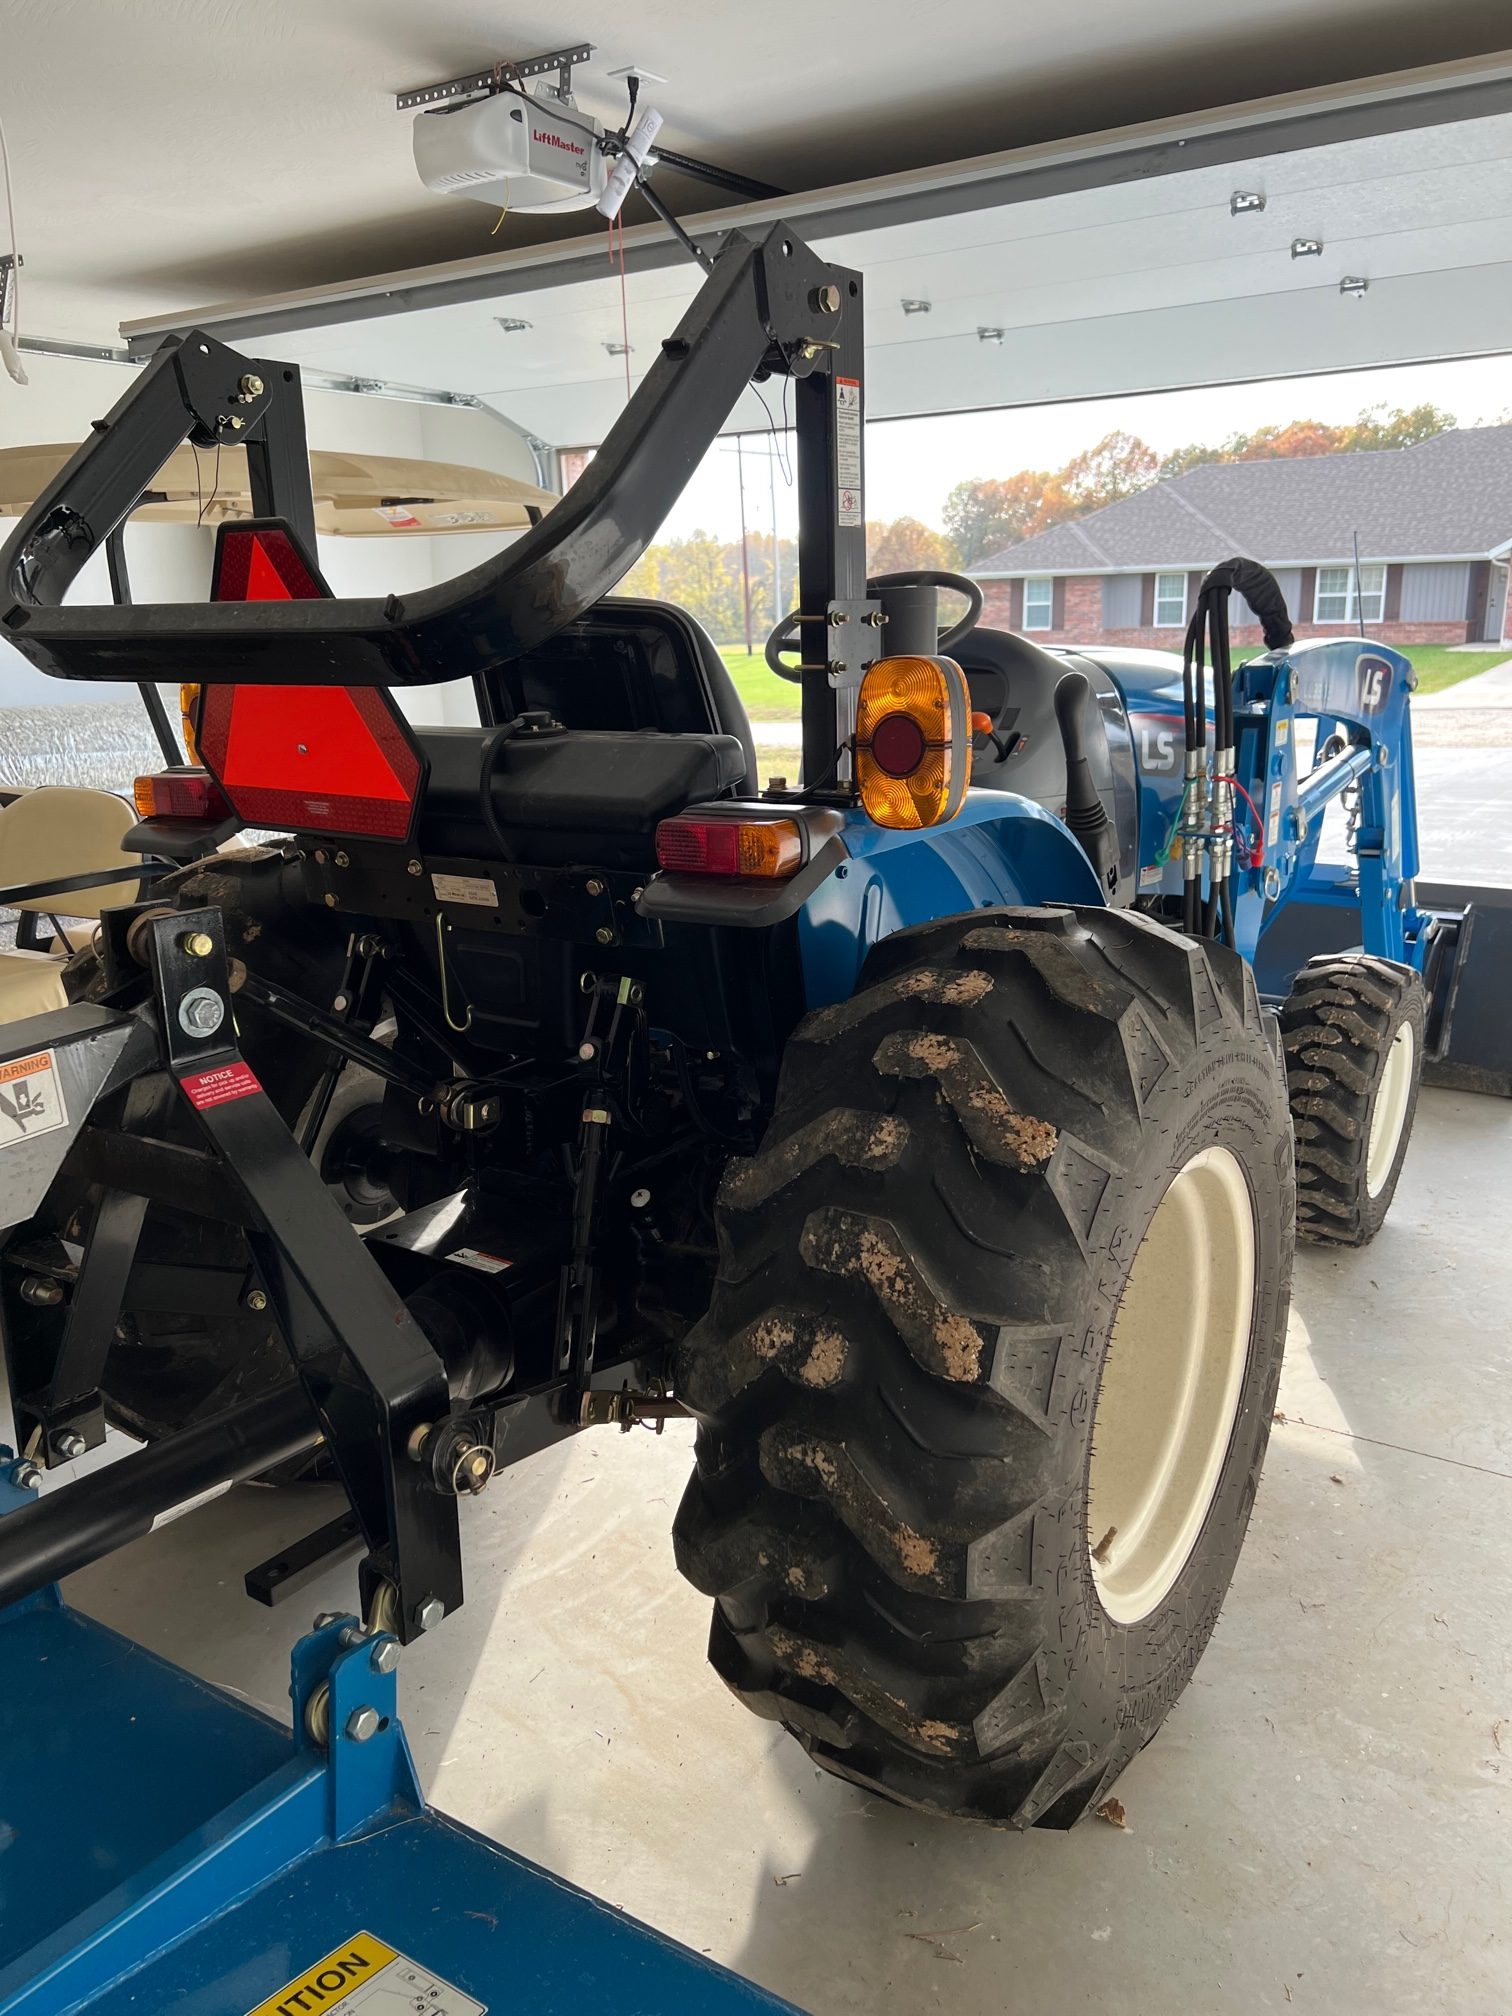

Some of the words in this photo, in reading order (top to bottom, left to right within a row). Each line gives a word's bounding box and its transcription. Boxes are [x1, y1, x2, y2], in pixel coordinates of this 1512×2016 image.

[533, 129, 585, 155] LiftMaster
[1361, 668, 1384, 706] LS
[1141, 729, 1175, 770] LS
[199, 1069, 235, 1086] NOTICE
